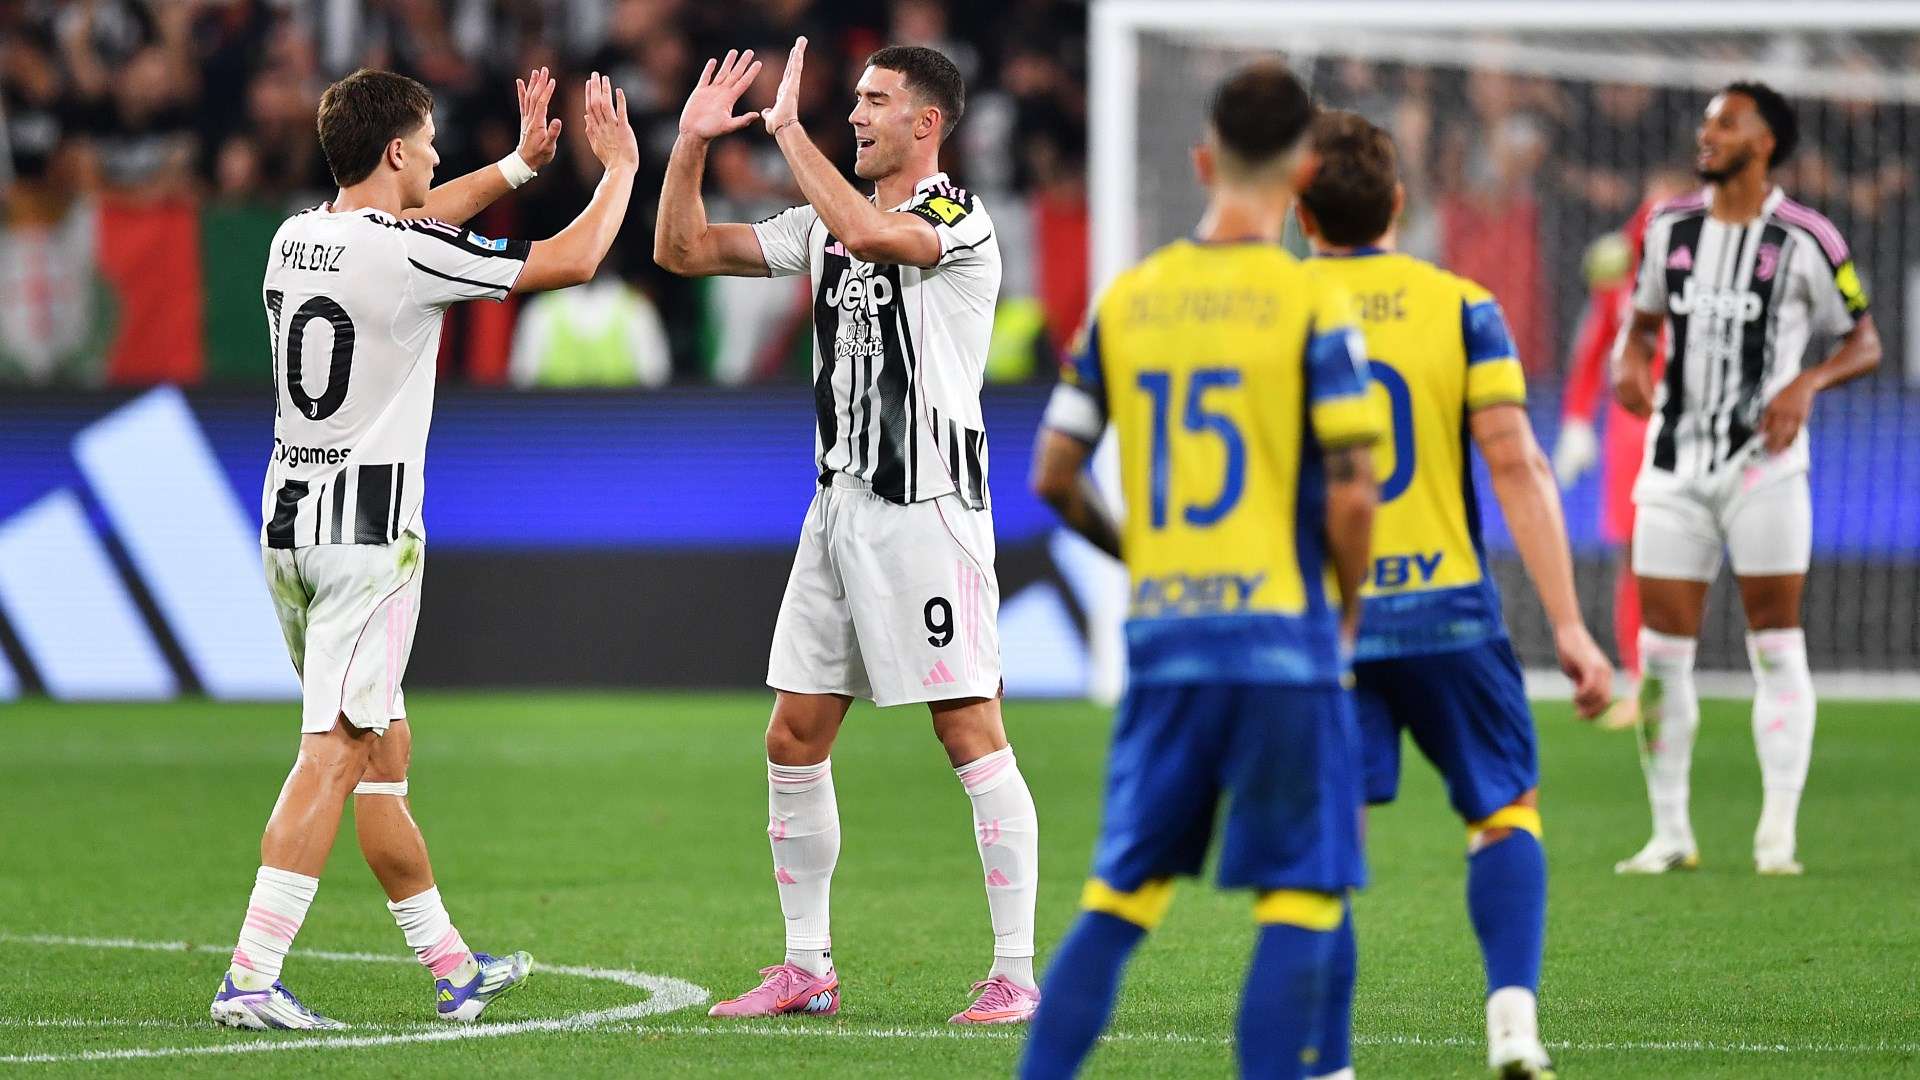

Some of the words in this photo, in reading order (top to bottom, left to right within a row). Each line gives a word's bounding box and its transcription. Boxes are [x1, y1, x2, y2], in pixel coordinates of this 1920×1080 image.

[281, 239, 346, 272] YILDIZ
[825, 268, 893, 317] Jep
[265, 289, 356, 421] 10
[1136, 367, 1246, 531] 15
[1362, 551, 1443, 589] BY
[923, 596, 955, 649] 9
